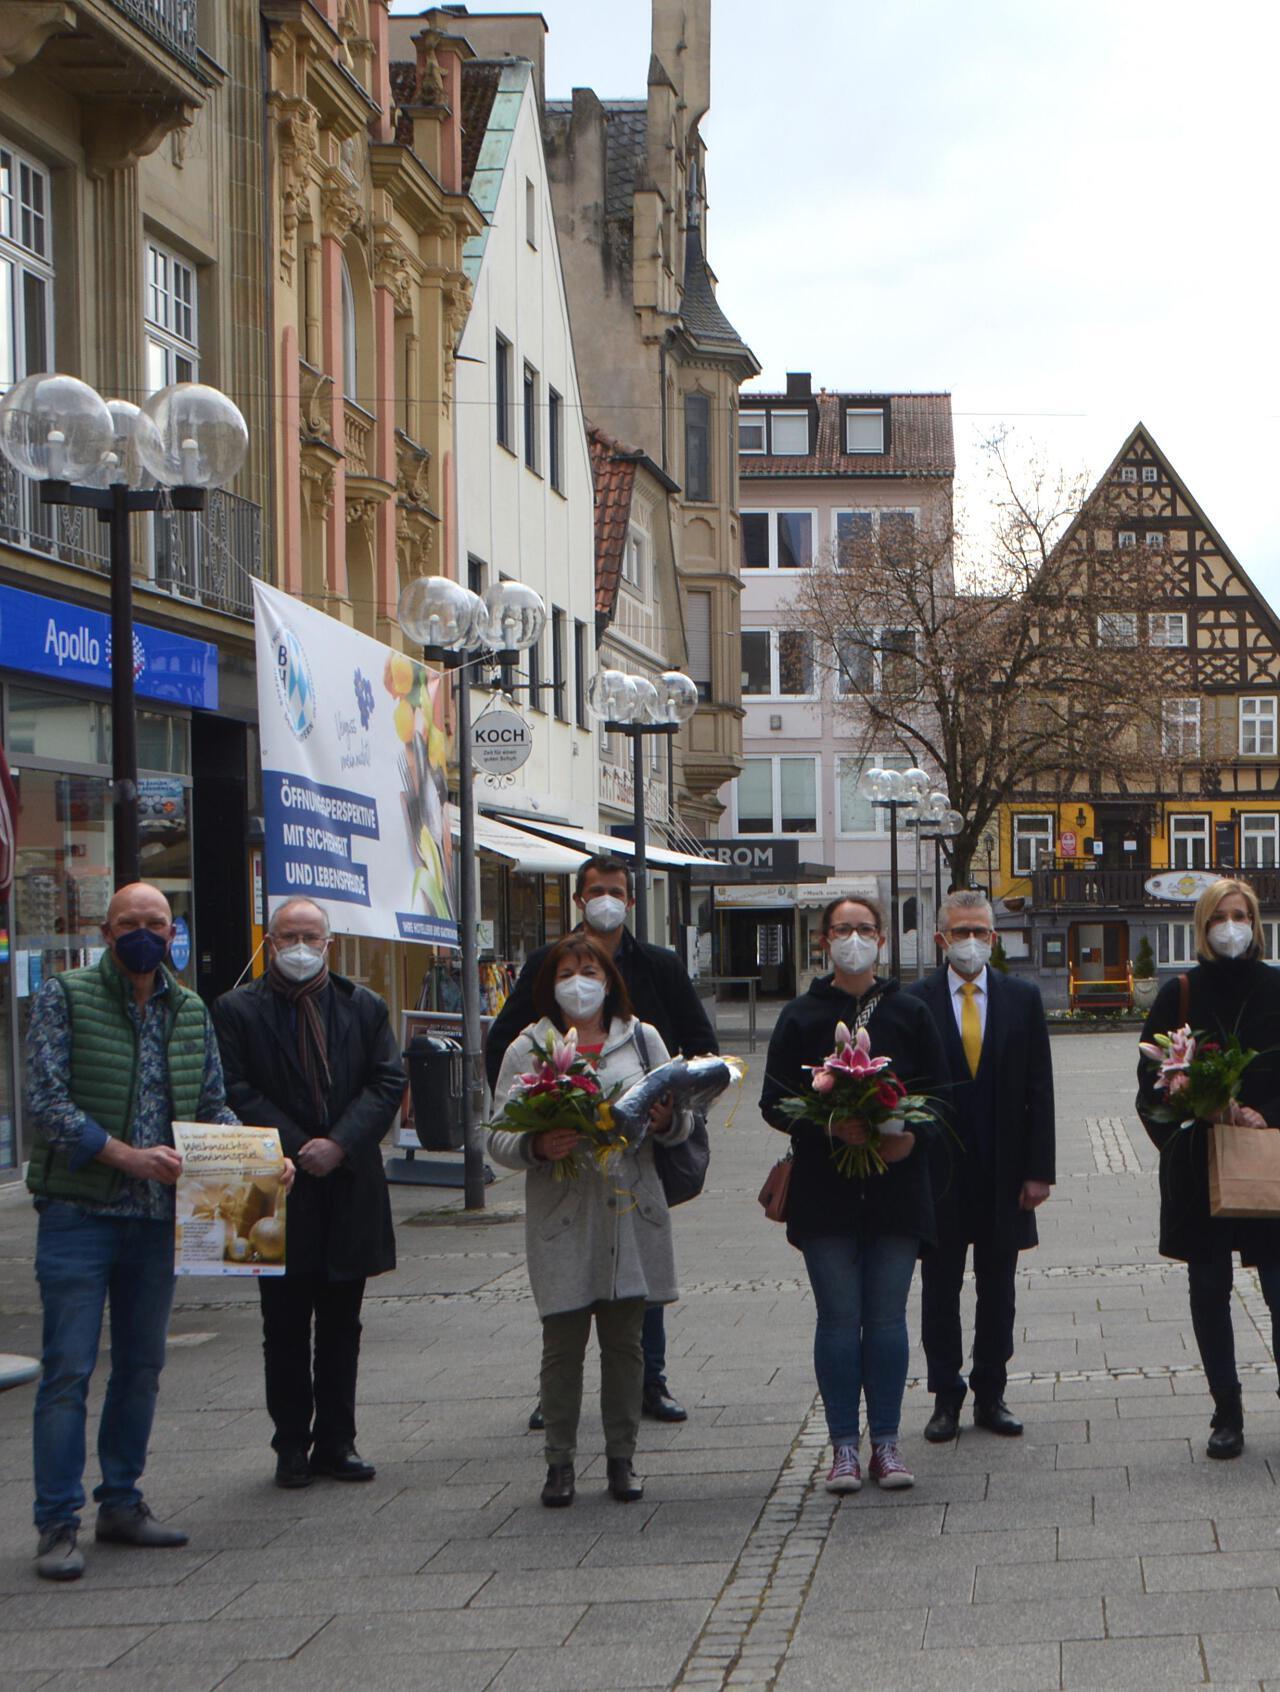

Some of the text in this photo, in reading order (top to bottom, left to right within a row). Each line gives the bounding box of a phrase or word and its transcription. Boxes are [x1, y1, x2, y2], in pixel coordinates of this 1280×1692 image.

[44, 618, 100, 666] Apollo
[475, 729, 525, 743] KOCH
[283, 823, 304, 848] MIT
[285, 862, 313, 885] UND
